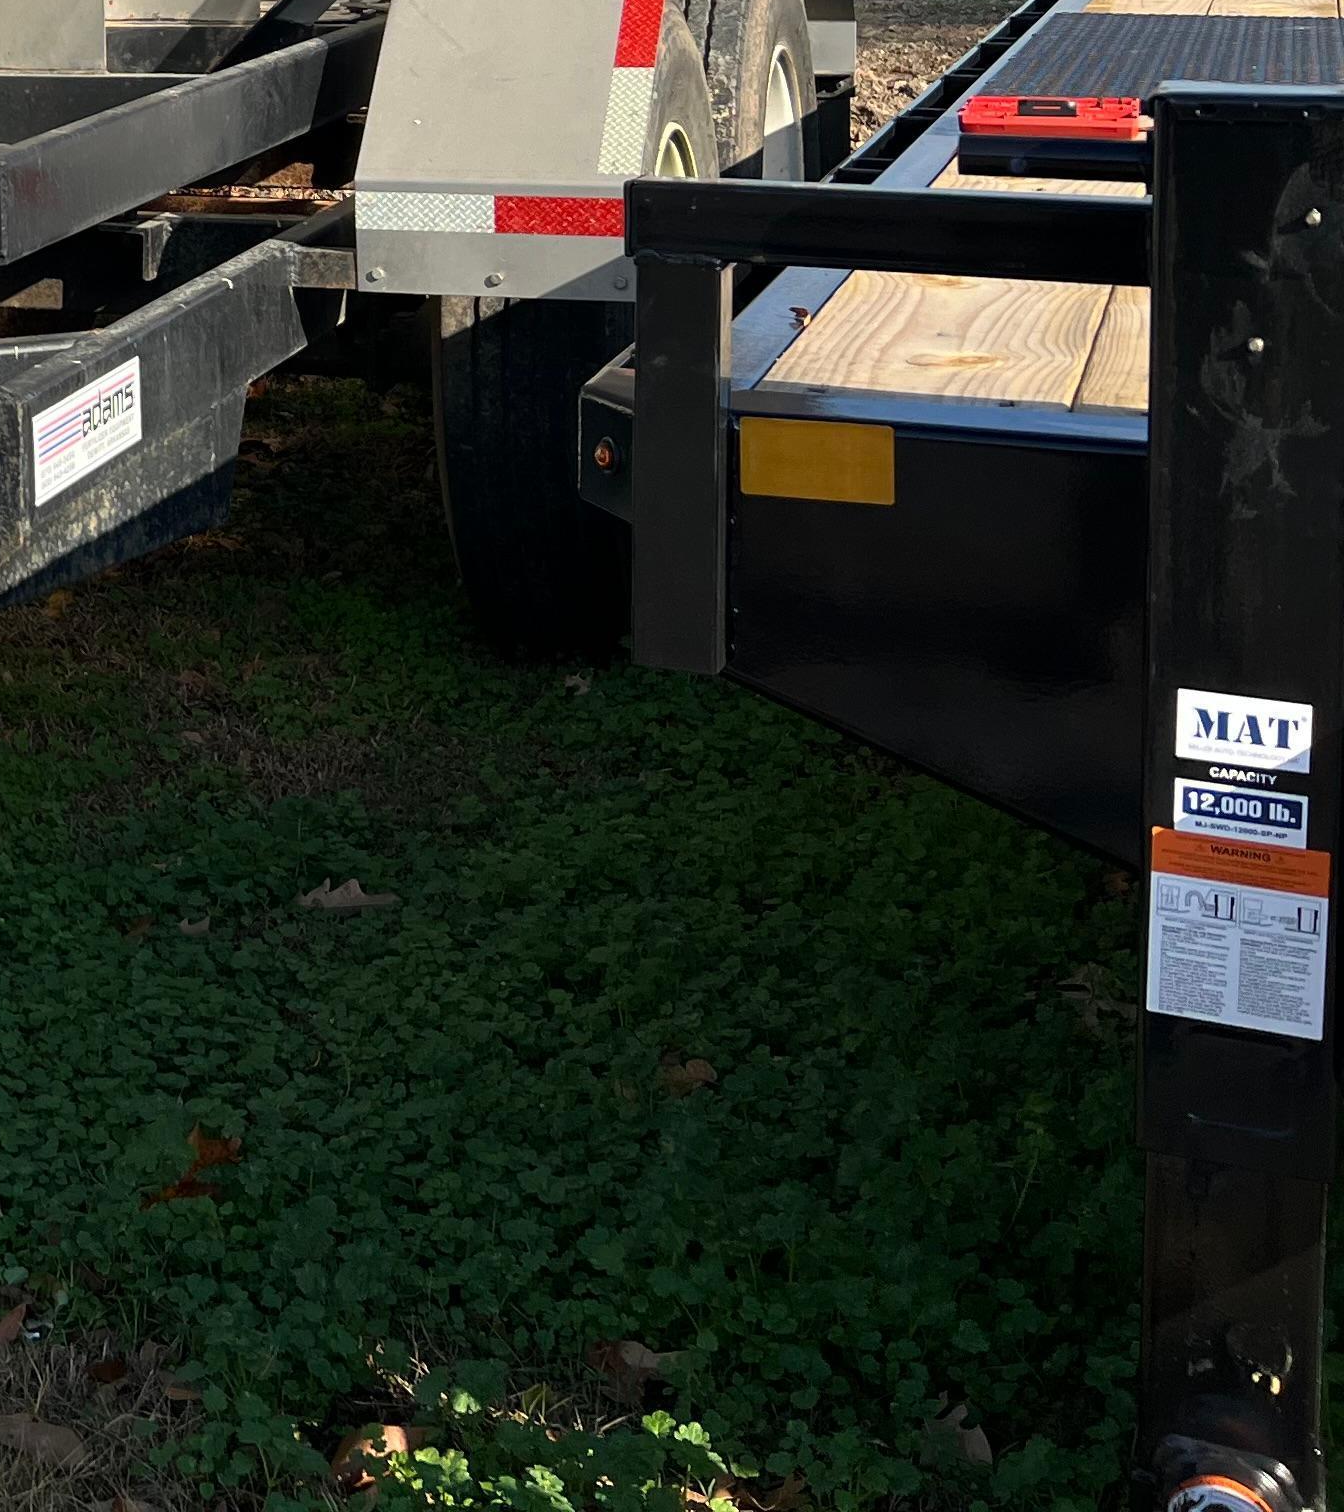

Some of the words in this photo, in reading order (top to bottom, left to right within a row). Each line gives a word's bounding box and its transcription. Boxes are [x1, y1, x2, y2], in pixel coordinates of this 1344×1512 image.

[82, 380, 135, 439] adams
[1194, 706, 1300, 750] MAT
[1209, 766, 1278, 786] CAPACITY
[1188, 790, 1263, 819] 12,000
[1269, 802, 1297, 824] lb.
[1210, 844, 1272, 863] WARNING
